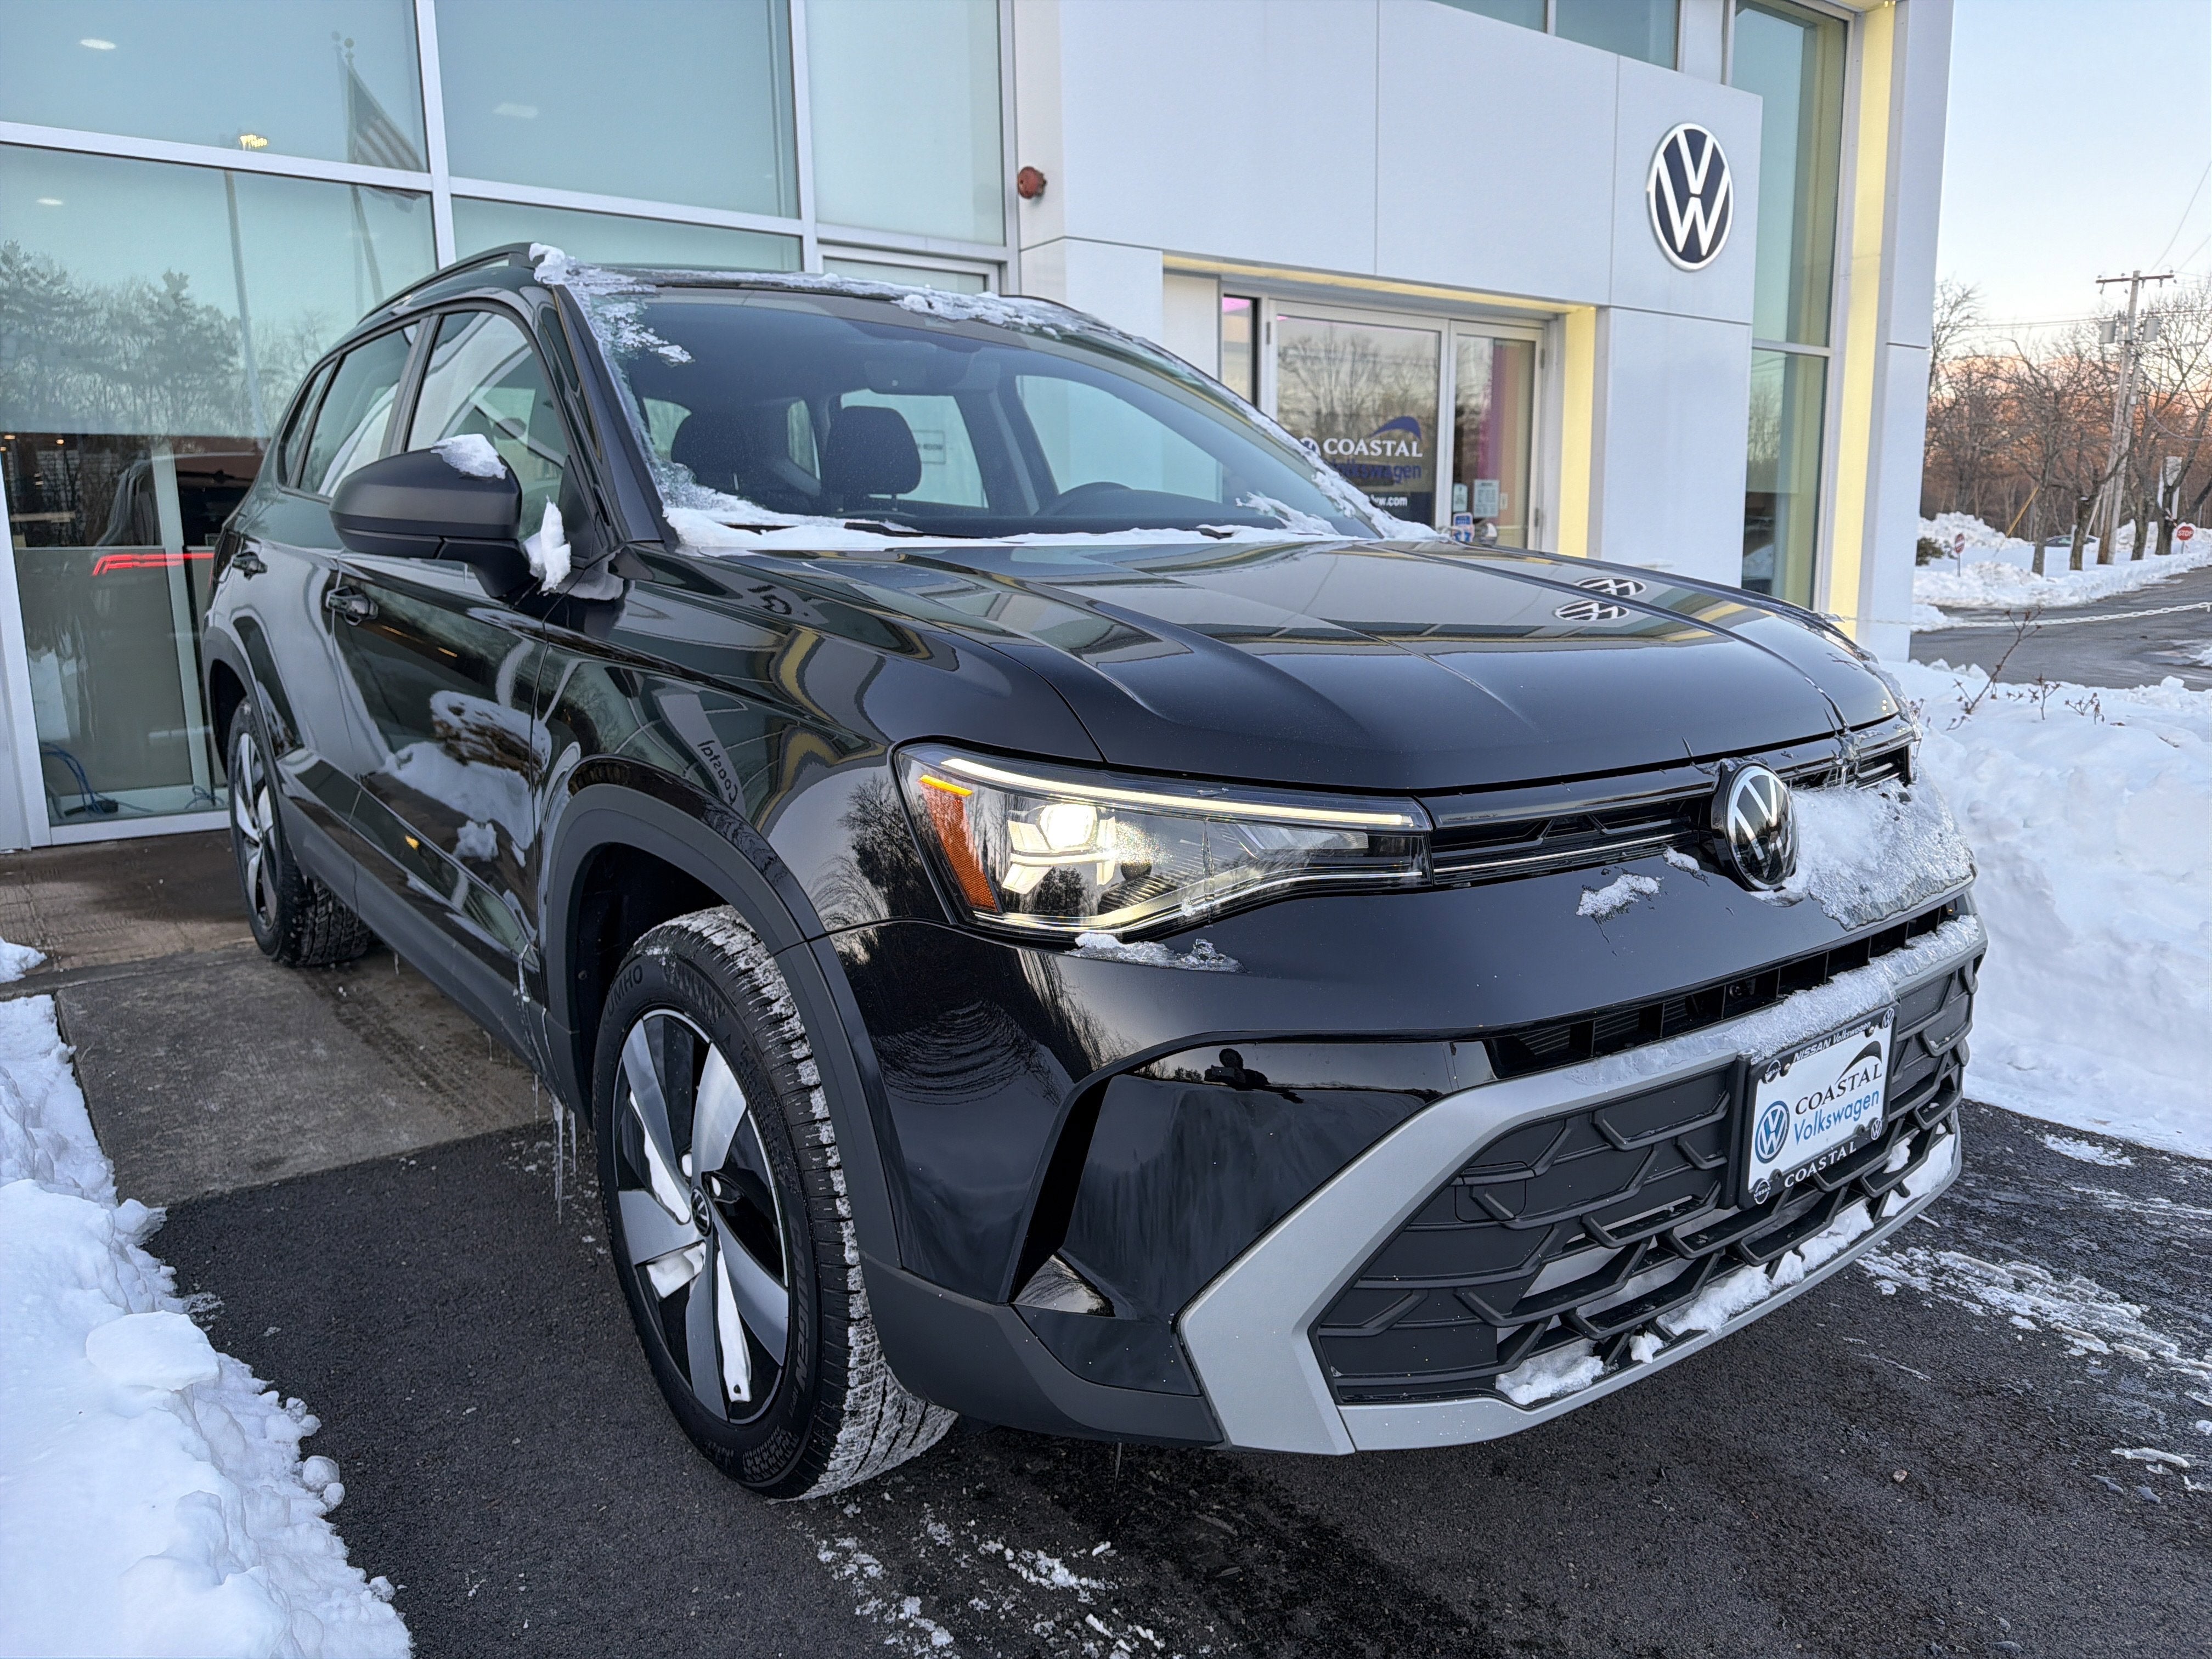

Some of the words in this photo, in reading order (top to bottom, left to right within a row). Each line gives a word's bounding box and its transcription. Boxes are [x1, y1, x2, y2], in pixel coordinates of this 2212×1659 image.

[1650, 125, 1733, 266] VW
[1323, 438, 1423, 458] COASTAL
[1331, 459, 1422, 483] olkswagen
[1793, 1038, 1831, 1063] NISSAN
[1833, 1021, 1872, 1044] Volkswagen
[1795, 1063, 1882, 1115] COASTAL
[1756, 1101, 1790, 1164] VW
[1794, 1090, 1880, 1146] Volkswagen
[1784, 1141, 1857, 1188] COASTAL
